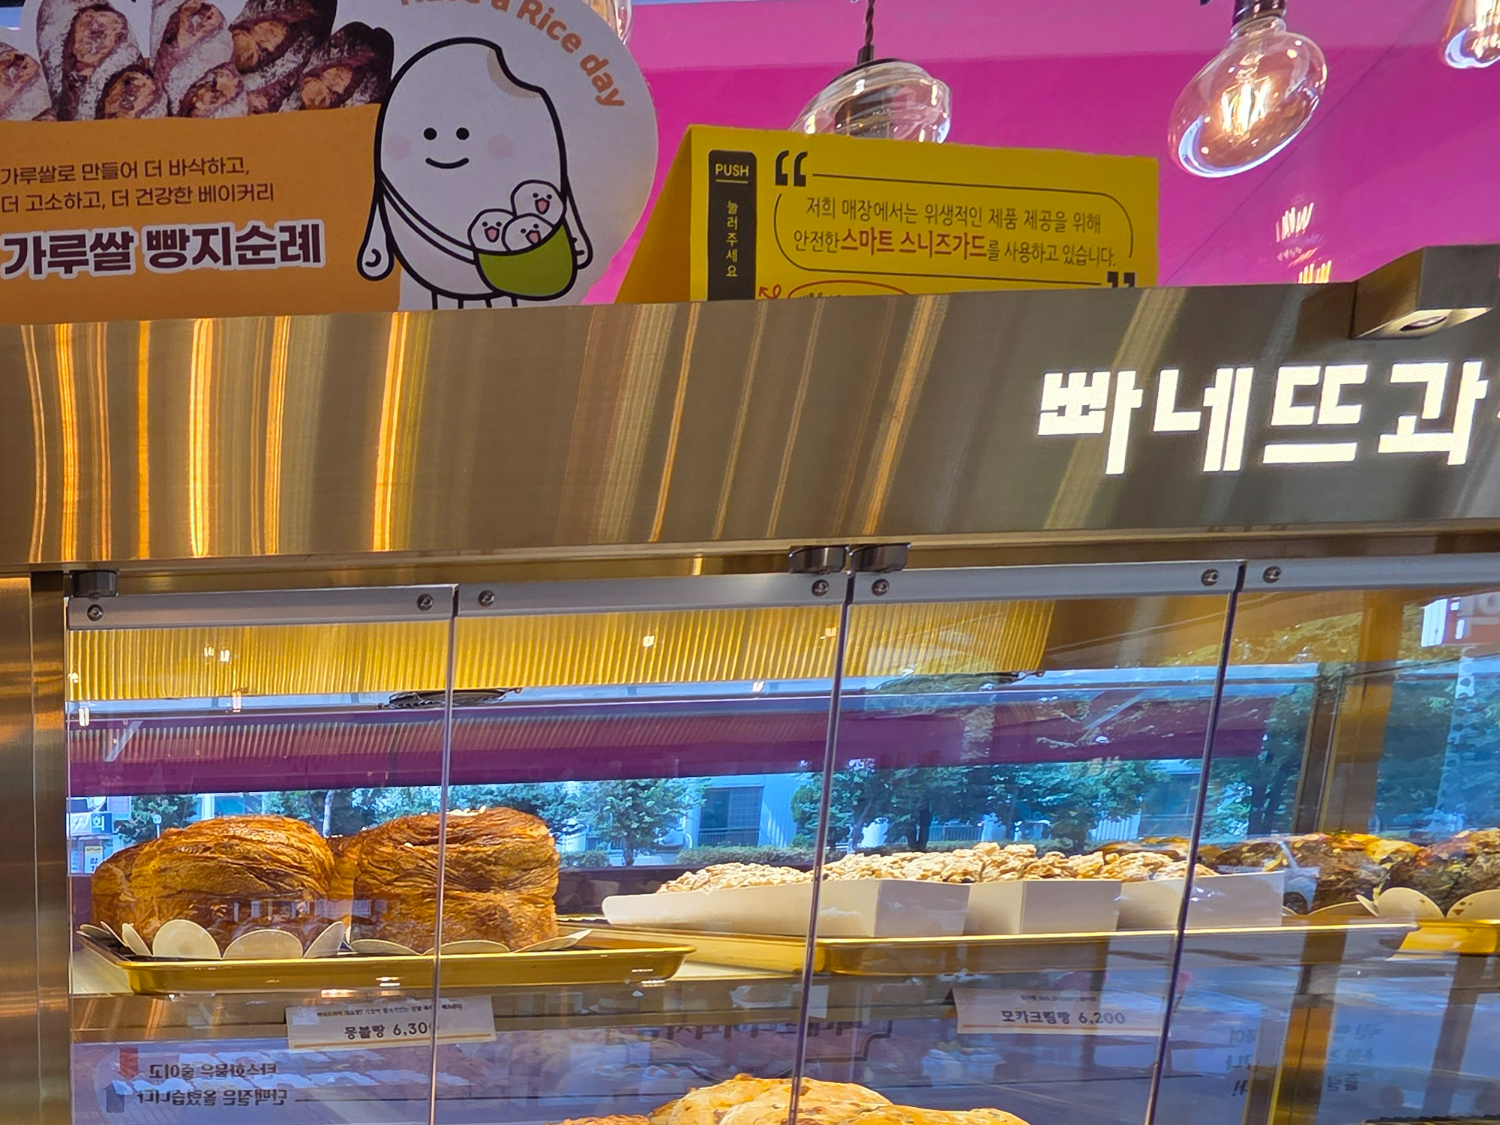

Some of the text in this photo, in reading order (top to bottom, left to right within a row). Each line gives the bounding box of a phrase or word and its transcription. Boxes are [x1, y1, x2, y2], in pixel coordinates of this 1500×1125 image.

[516, 0, 625, 107] Rice day
[1, 156, 250, 186] 가루쌀로 만들어 더 바삭하고,
[715, 163, 749, 177] PUSH
[2, 182, 275, 214] 더 고소하고, 더 건강한 베이커리
[806, 197, 1101, 234] 저희 매장에서는 위생적인 제품 제공을 위해
[3, 223, 322, 276] 가루쌀 빵지순례
[899, 229, 1000, 262] 스니즈가드를
[1004, 241, 1059, 264] 사용하고
[1062, 244, 1117, 267] 있습니다.
[1037, 360, 1500, 475] 빠네뜨과
[344, 1021, 435, 1040] 몽블랑 6,30
[1001, 1010, 1126, 1025] 모카크림빵 6,200
